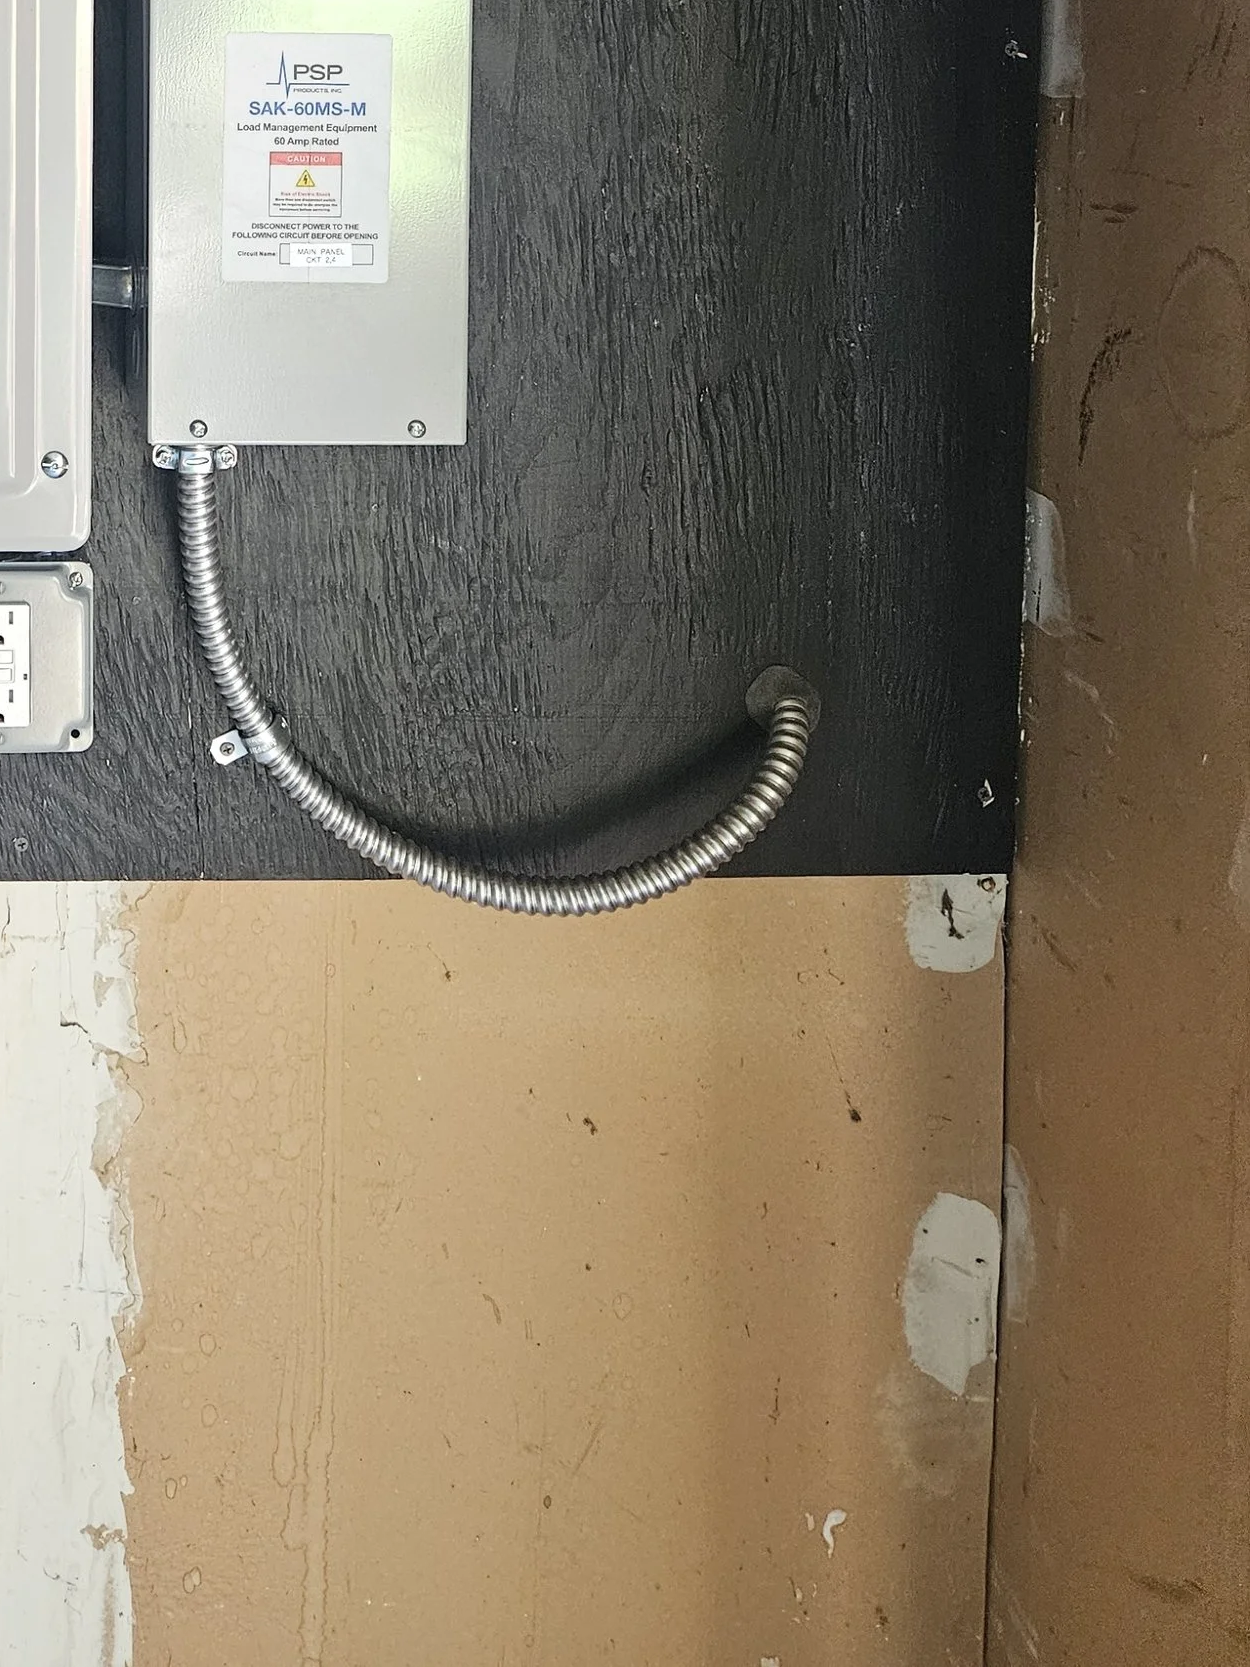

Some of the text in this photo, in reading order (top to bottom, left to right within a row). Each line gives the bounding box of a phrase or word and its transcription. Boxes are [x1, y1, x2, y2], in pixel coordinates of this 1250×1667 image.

[293, 64, 343, 80] PSP
[249, 101, 367, 116] SAK-60MS-M
[237, 123, 378, 134] Load Management Equipment
[274, 137, 340, 147] 60 Amp Rated
[287, 155, 326, 163] CAUTION
[345, 223, 359, 231] THE
[325, 257, 336, 265] 2,4
